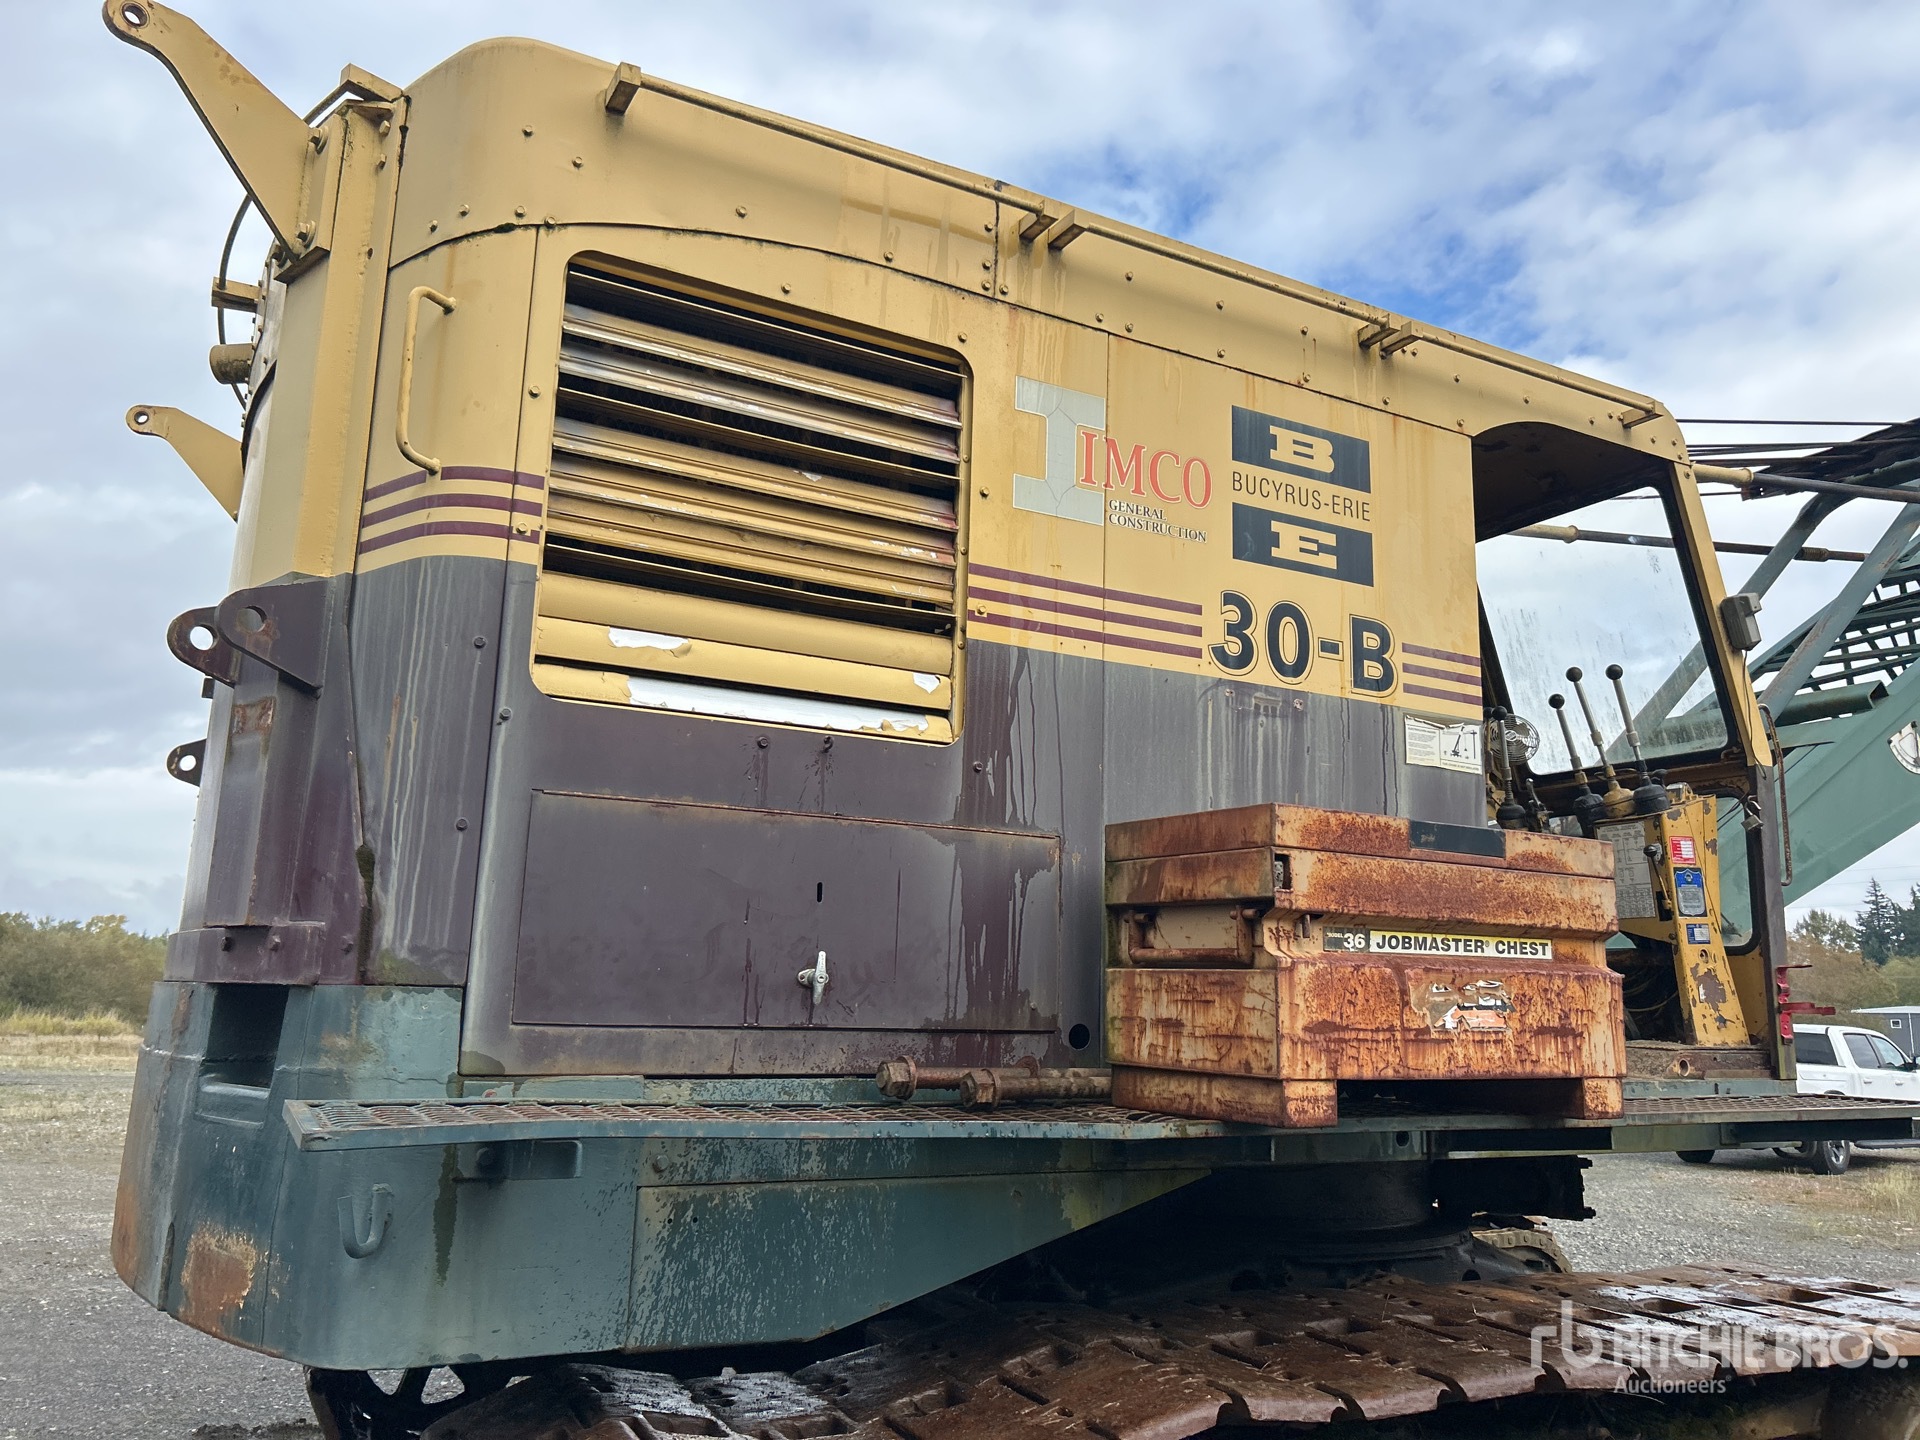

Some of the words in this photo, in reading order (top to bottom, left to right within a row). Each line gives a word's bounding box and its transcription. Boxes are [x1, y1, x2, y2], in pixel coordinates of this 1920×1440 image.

[1080, 430, 1213, 509] IMCO
[1269, 425, 1335, 474] B
[1108, 499, 1167, 521] GENERAL
[1232, 471, 1372, 522] BUCYRUS-ERIE
[1108, 513, 1208, 543] CONSTRUCTION
[1271, 520, 1338, 570] E
[1208, 590, 1399, 698] 30-B
[1343, 933, 1366, 949] 36
[1495, 940, 1549, 956] CHEST
